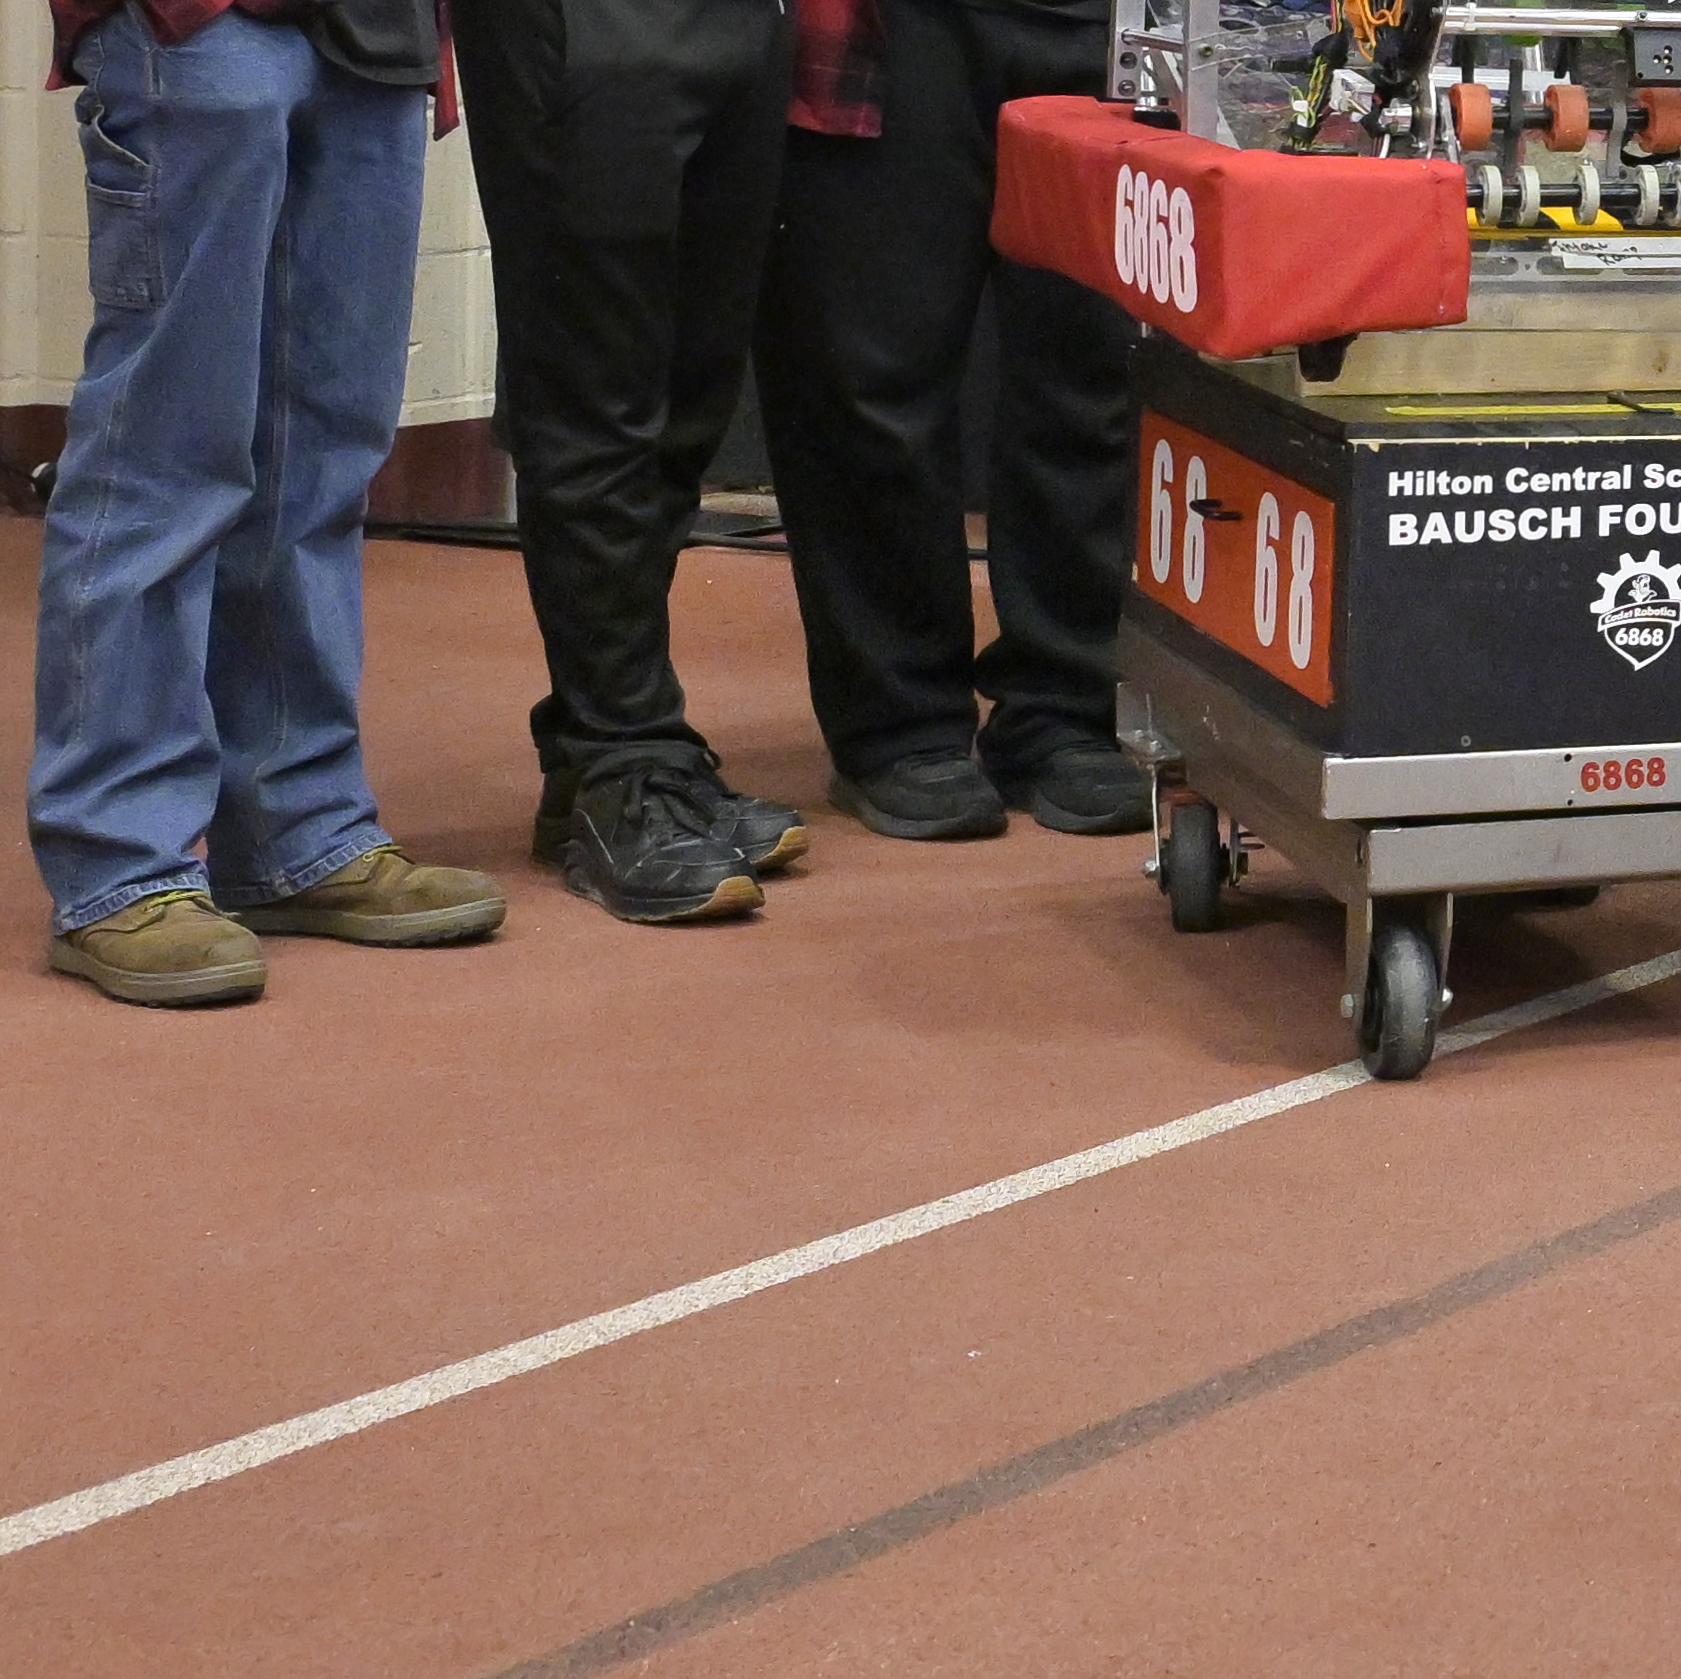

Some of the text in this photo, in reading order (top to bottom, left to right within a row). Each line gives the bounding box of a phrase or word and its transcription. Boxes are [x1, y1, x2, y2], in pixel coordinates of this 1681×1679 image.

[1115, 164, 1198, 313] 6868
[1388, 469, 1493, 497] Hilton
[1505, 464, 1632, 494] Central
[1388, 506, 1582, 546] BAUSCH
[1604, 606, 1676, 624] Cadet Robotics
[1615, 628, 1664, 646] 6868
[1581, 757, 1666, 792] 6868
